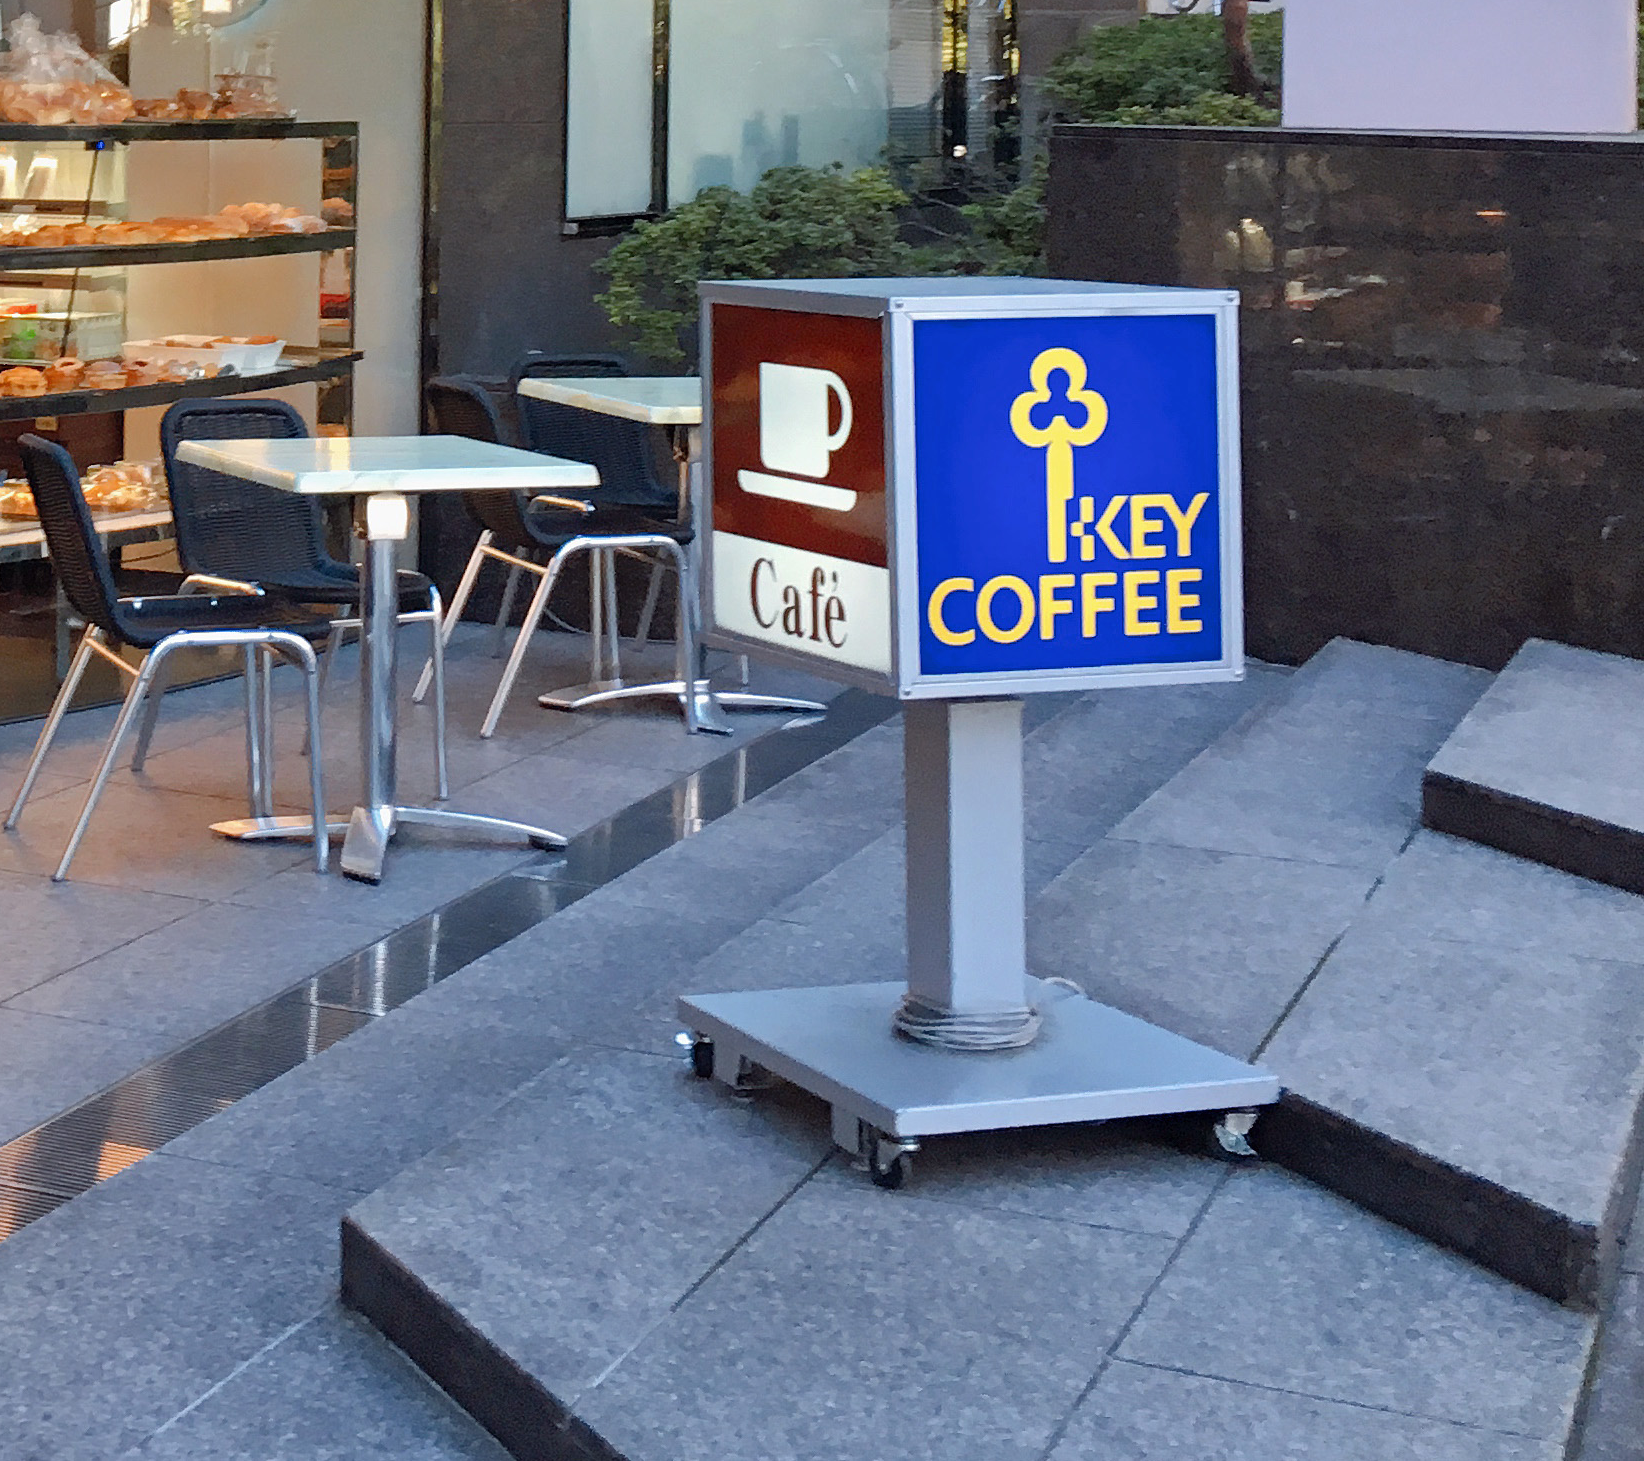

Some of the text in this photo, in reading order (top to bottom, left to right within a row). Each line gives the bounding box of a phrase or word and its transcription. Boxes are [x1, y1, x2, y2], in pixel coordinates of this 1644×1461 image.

[1078, 492, 1211, 561] KEY
[749, 556, 849, 649] Café
[926, 567, 1205, 647] COFFEE
